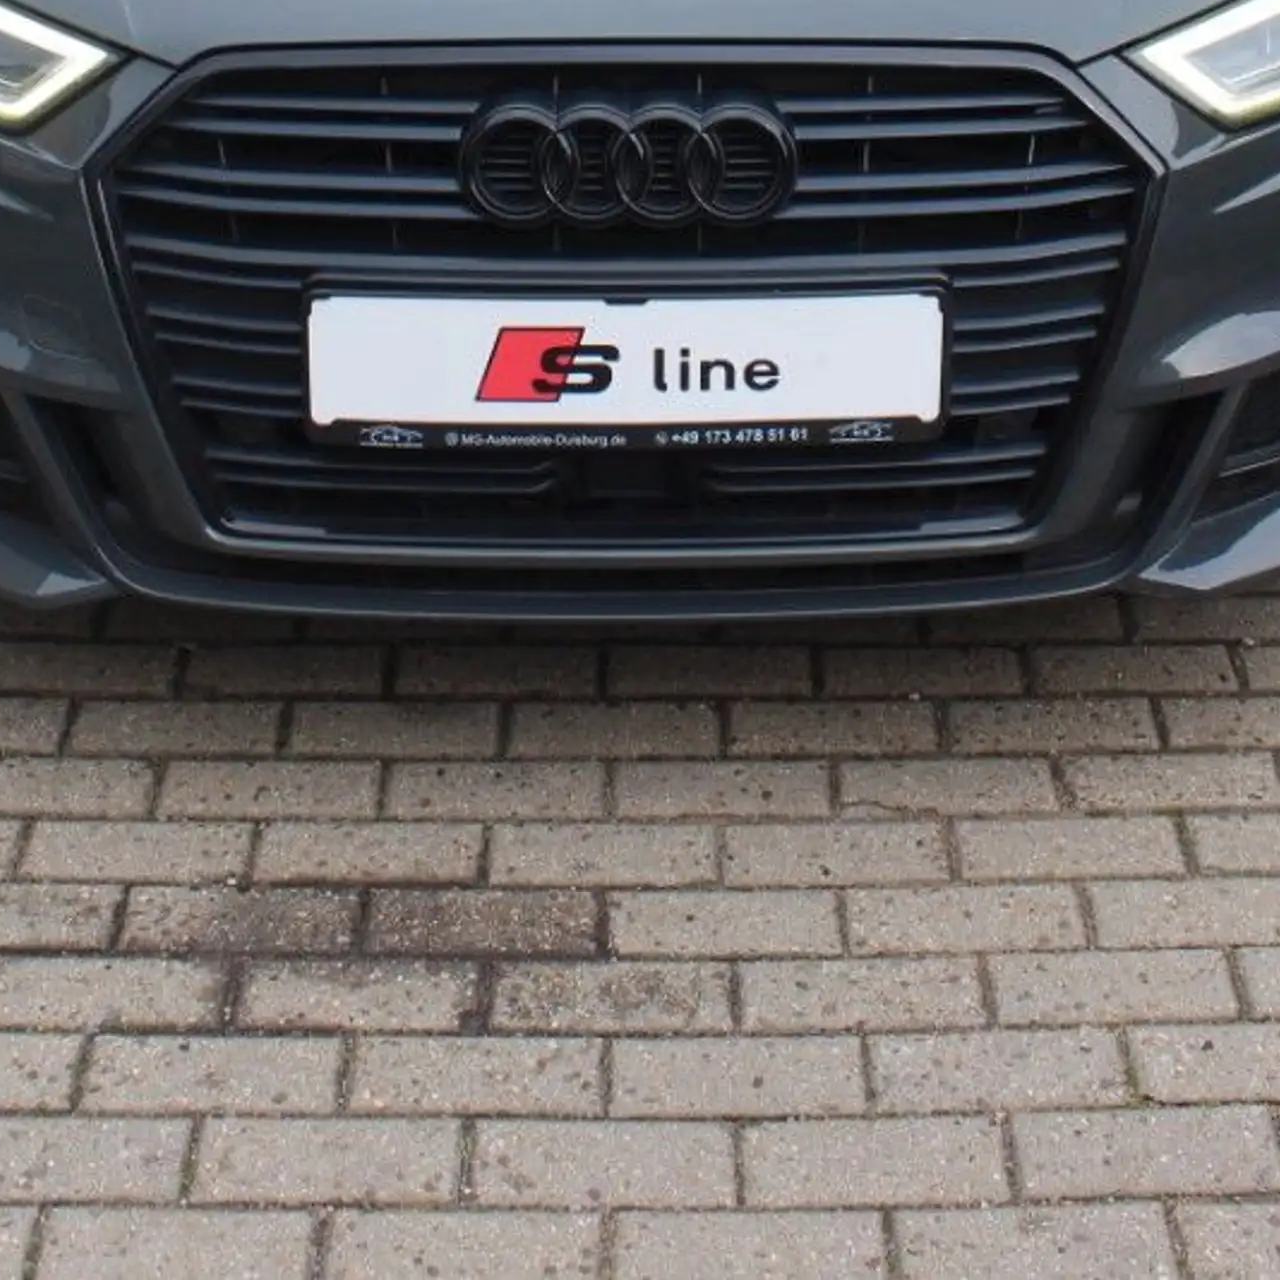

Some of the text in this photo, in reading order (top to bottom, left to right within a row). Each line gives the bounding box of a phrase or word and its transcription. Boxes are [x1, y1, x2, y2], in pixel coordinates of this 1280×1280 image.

[531, 344, 782, 393] S line
[671, 430, 700, 445] +49
[705, 428, 732, 445] 173
[735, 427, 762, 444] 478
